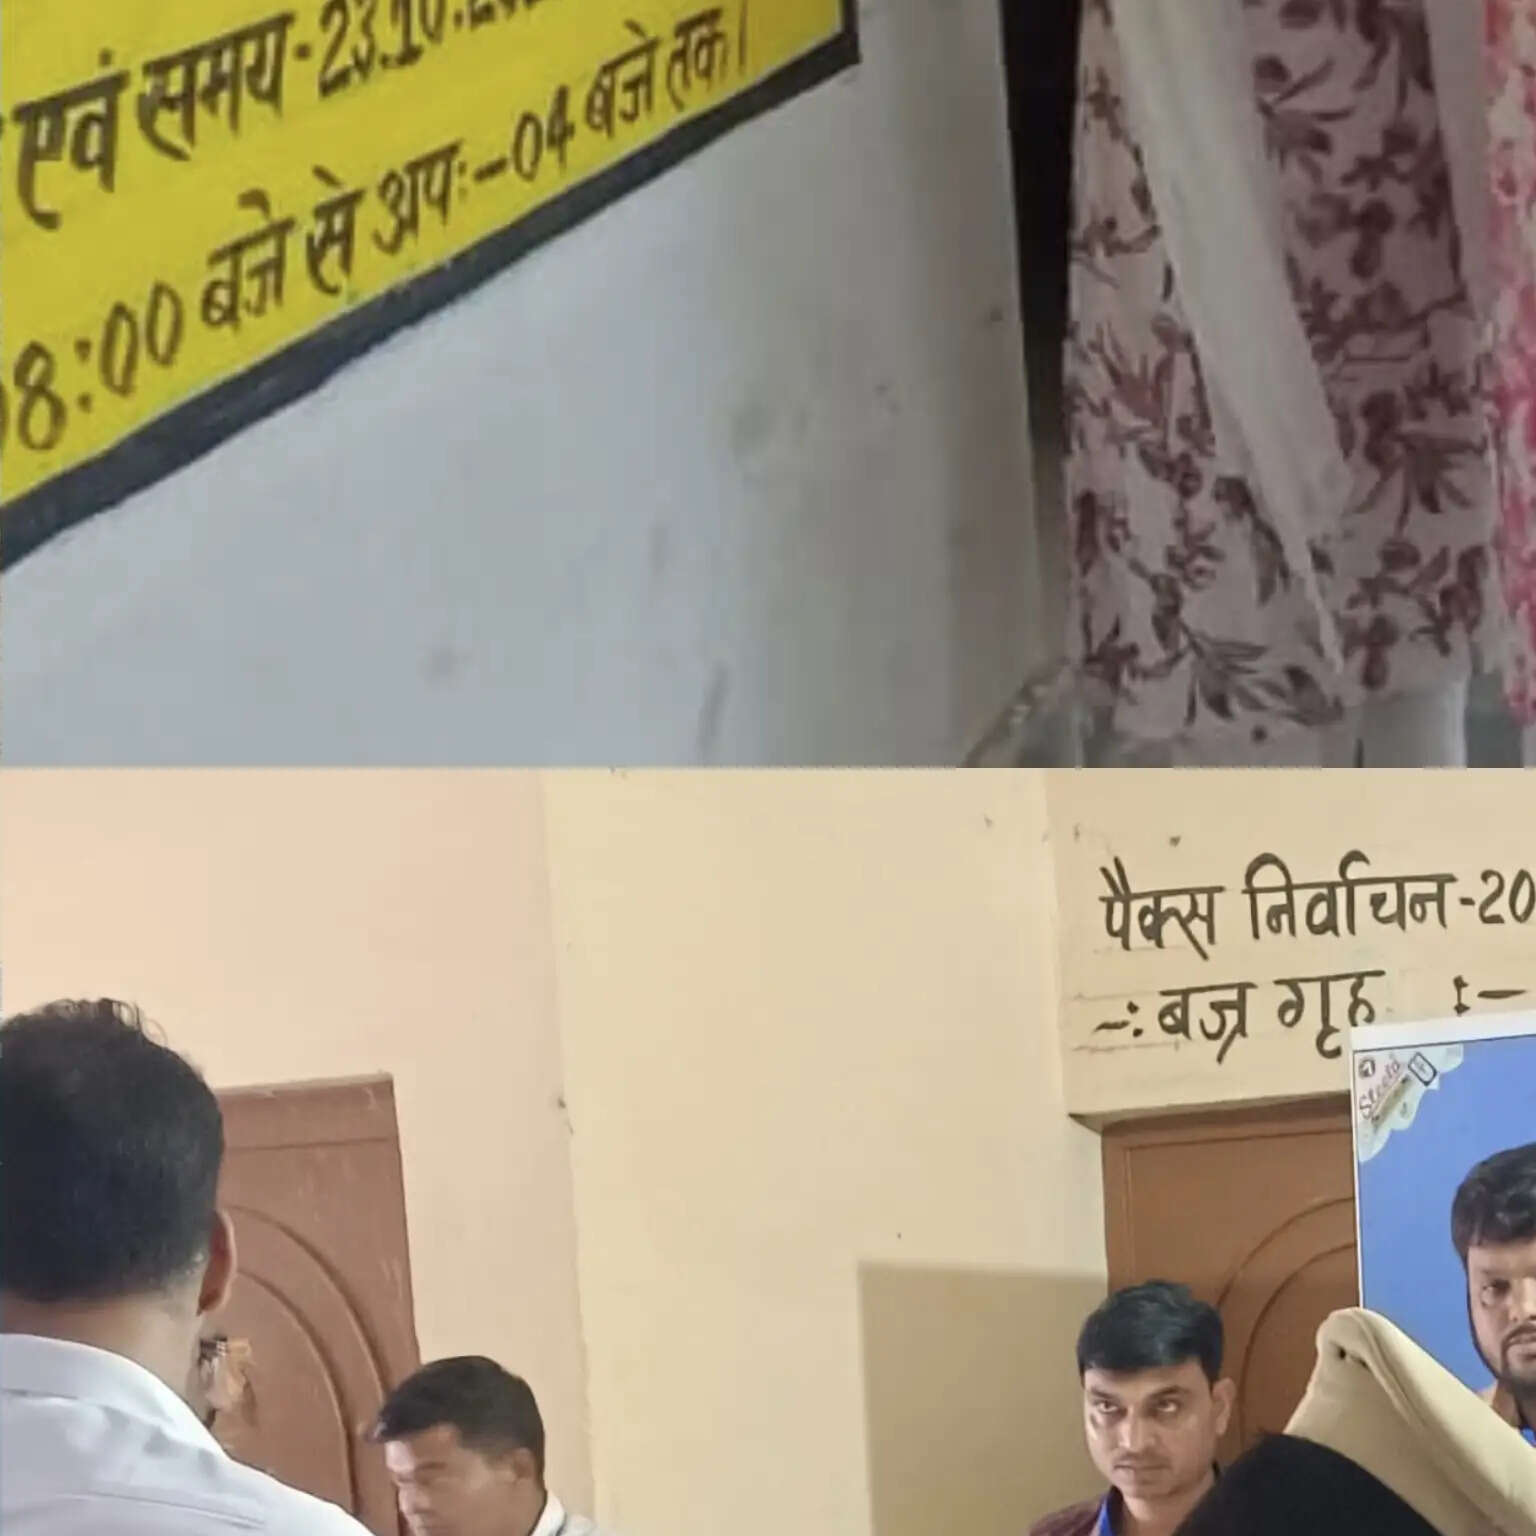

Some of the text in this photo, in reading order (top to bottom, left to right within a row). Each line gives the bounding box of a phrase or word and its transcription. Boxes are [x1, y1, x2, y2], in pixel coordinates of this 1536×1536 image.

[13, 47, 130, 231] एवं
[200, 188, 295, 332] बजे
[305, 167, 369, 295] से
[584, 19, 660, 140] बजे
[1099, 855, 1225, 961] पैक्स
